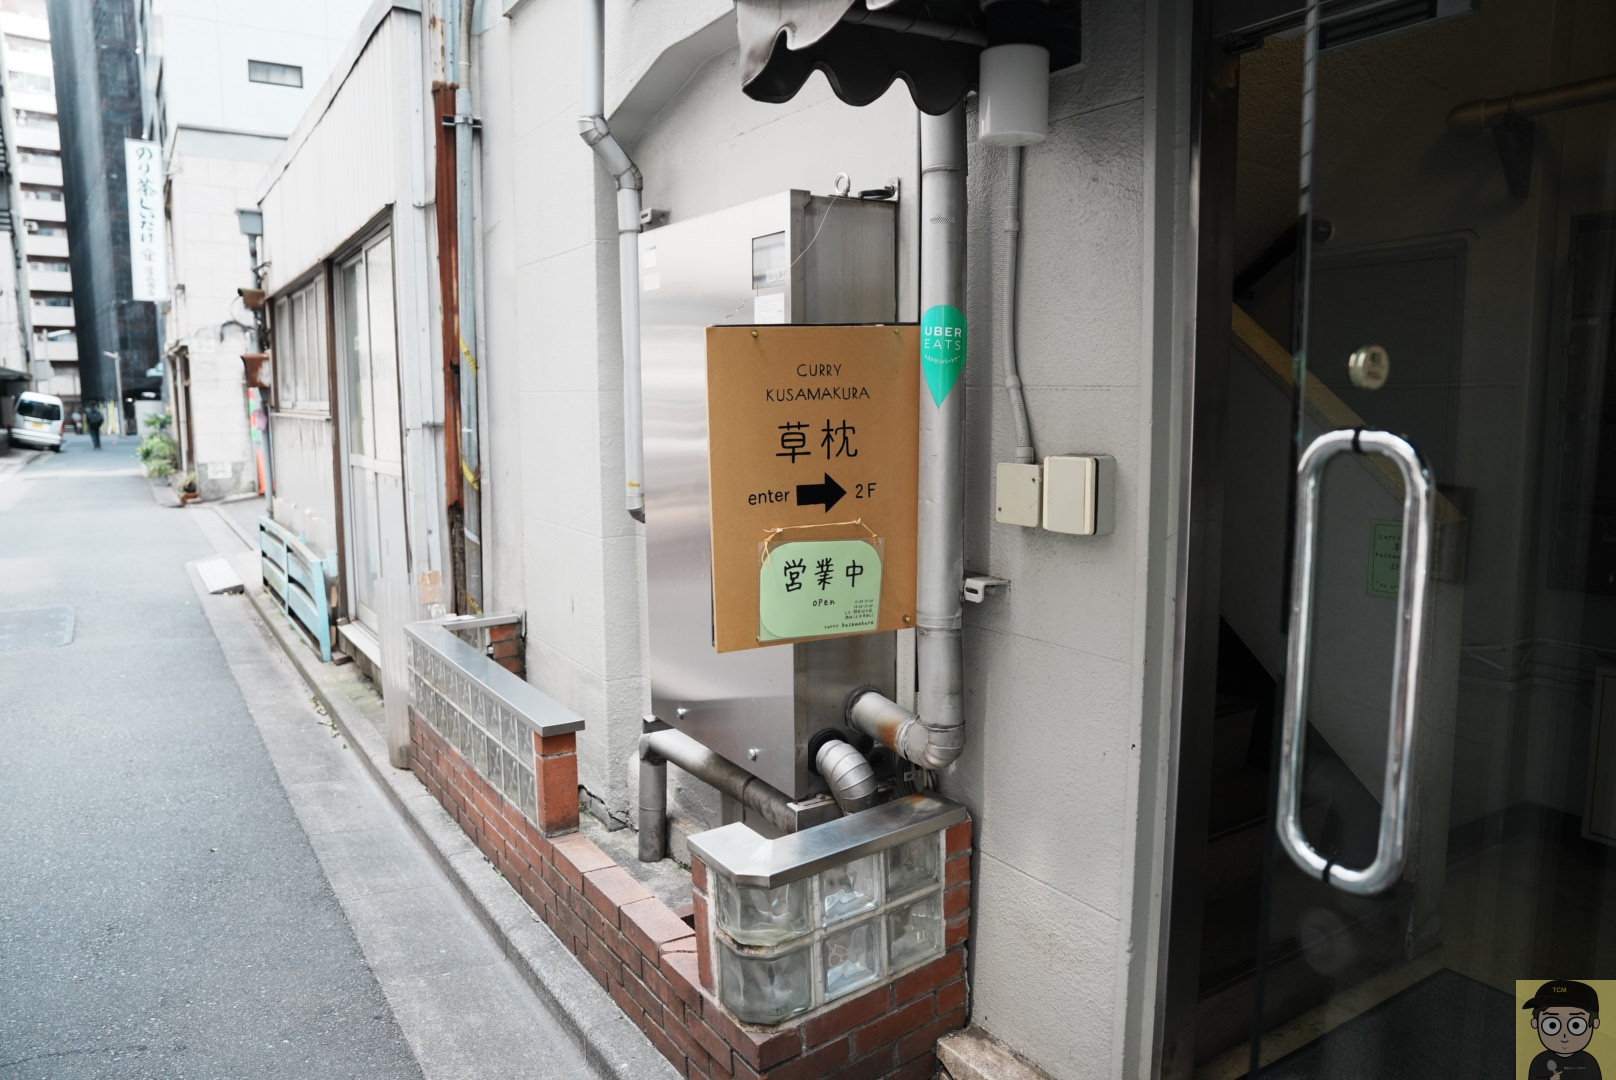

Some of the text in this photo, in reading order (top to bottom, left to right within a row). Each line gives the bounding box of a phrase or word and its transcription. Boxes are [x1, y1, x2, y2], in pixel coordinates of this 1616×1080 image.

[924, 326, 962, 338] UBER
[924, 338, 961, 351] EATS
[796, 363, 842, 377] CURRY
[766, 387, 870, 401] KUSAMAKURA
[775, 418, 858, 464] 草枕
[748, 482, 877, 505] enter 2F
[783, 557, 864, 593] 営業中
